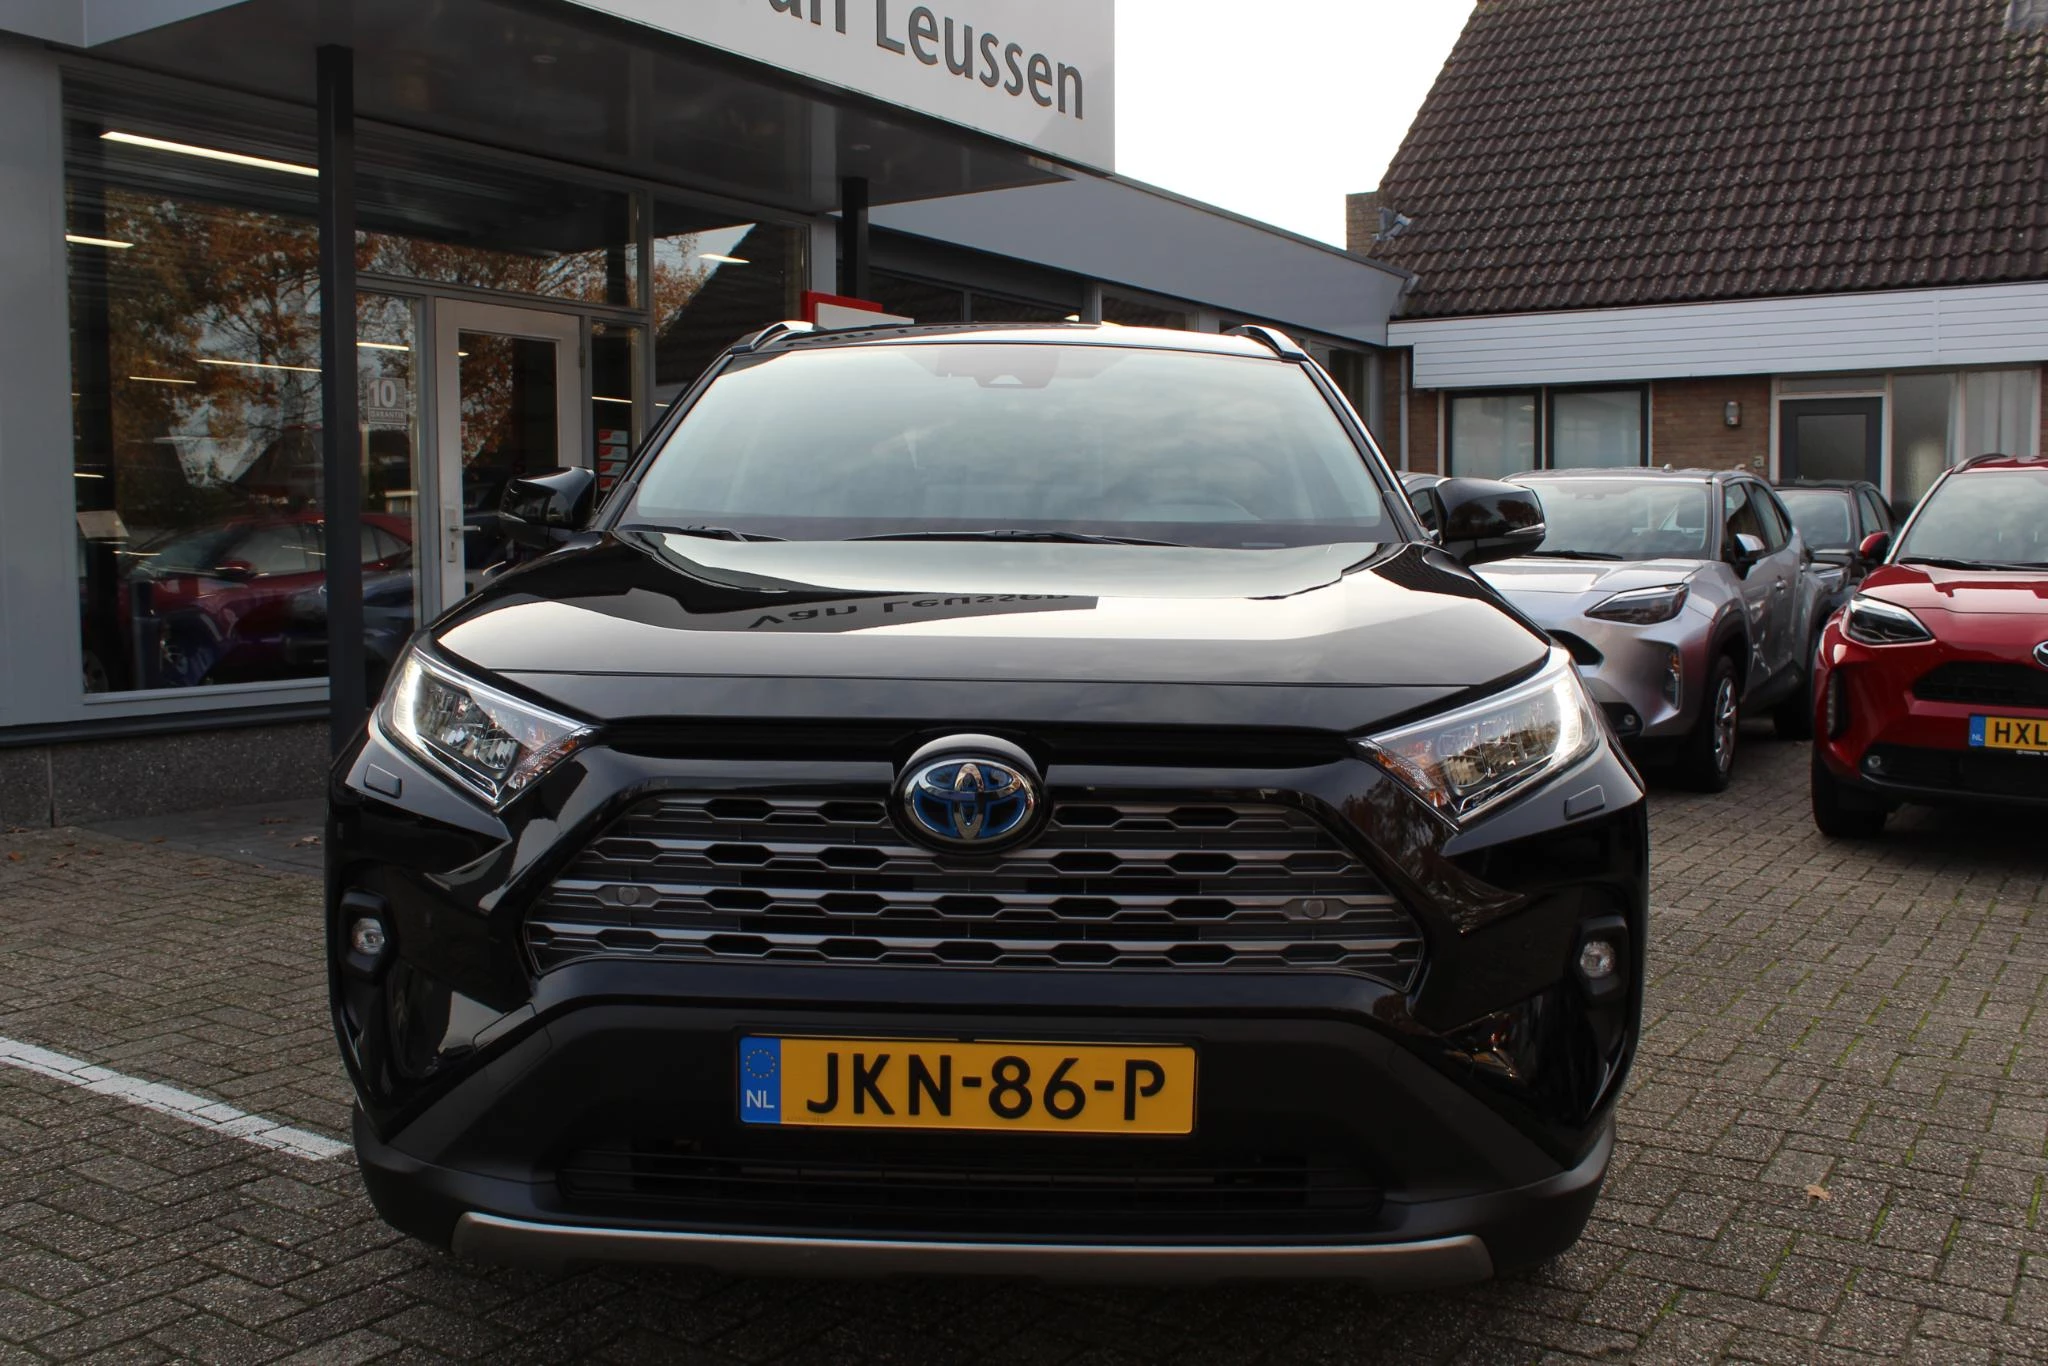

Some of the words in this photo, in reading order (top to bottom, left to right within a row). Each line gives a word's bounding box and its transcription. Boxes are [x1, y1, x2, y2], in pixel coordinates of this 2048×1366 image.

[876, 0, 1083, 120] Leussen
[369, 380, 396, 408] 10
[1994, 721, 2048, 746] HXL
[746, 1088, 775, 1109] NL
[806, 1052, 1166, 1121] JKN-86-P
